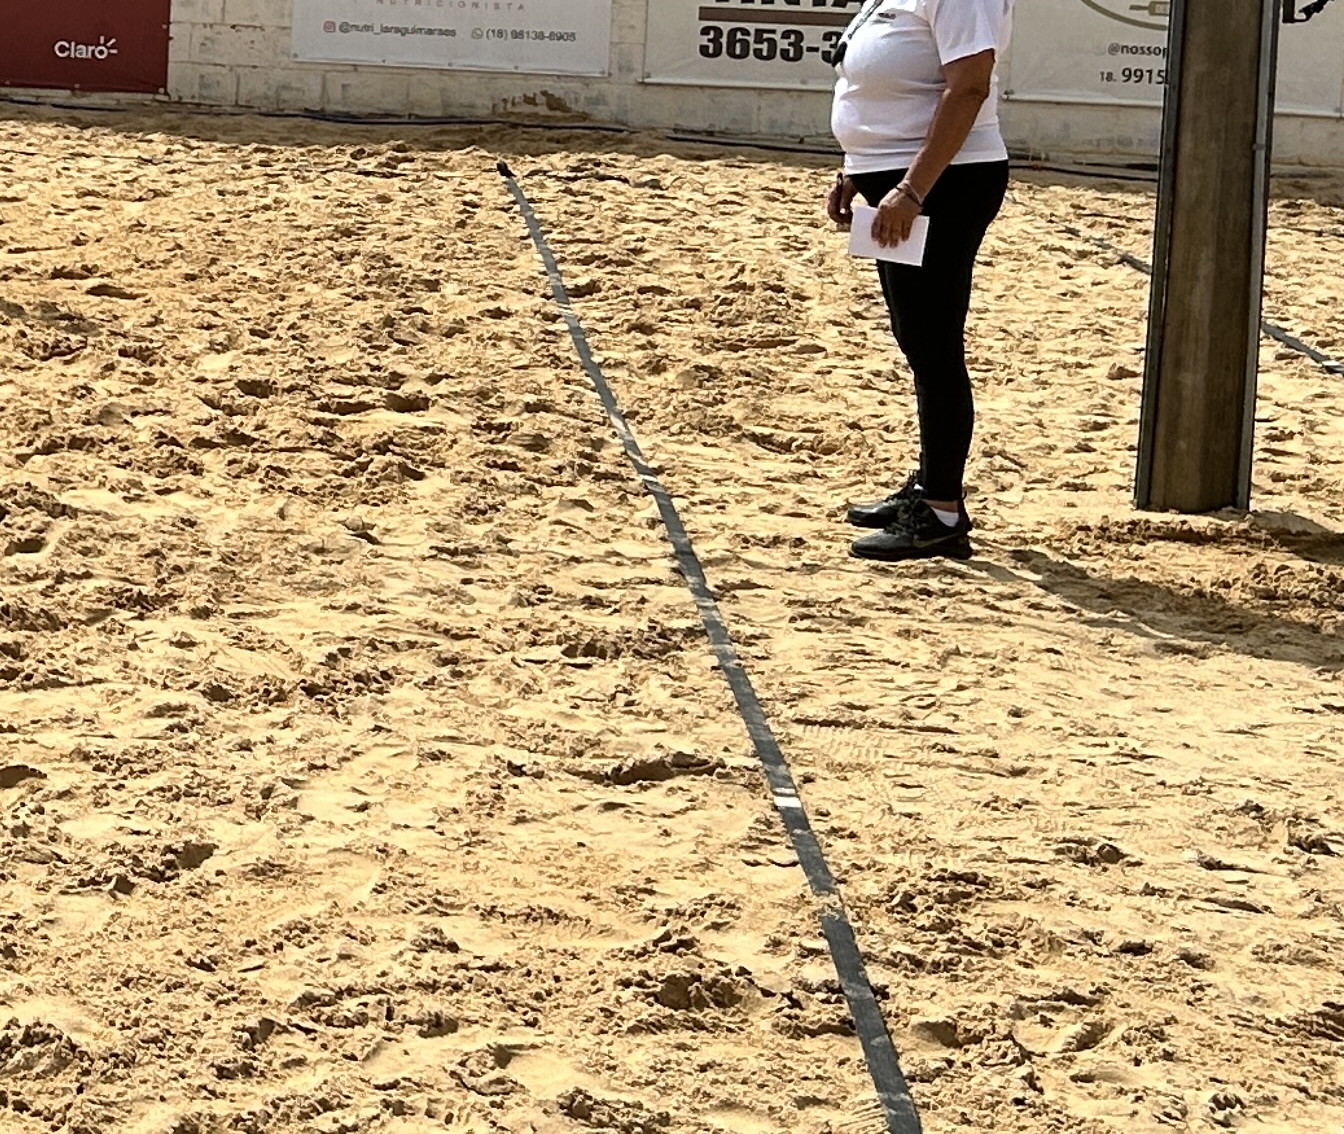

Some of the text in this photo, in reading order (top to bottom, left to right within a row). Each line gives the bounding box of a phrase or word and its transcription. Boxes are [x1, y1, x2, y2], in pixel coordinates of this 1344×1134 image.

[54, 39, 109, 59] Claro
[698, 26, 843, 64] 3653-3
[1121, 68, 1169, 85] 9915
